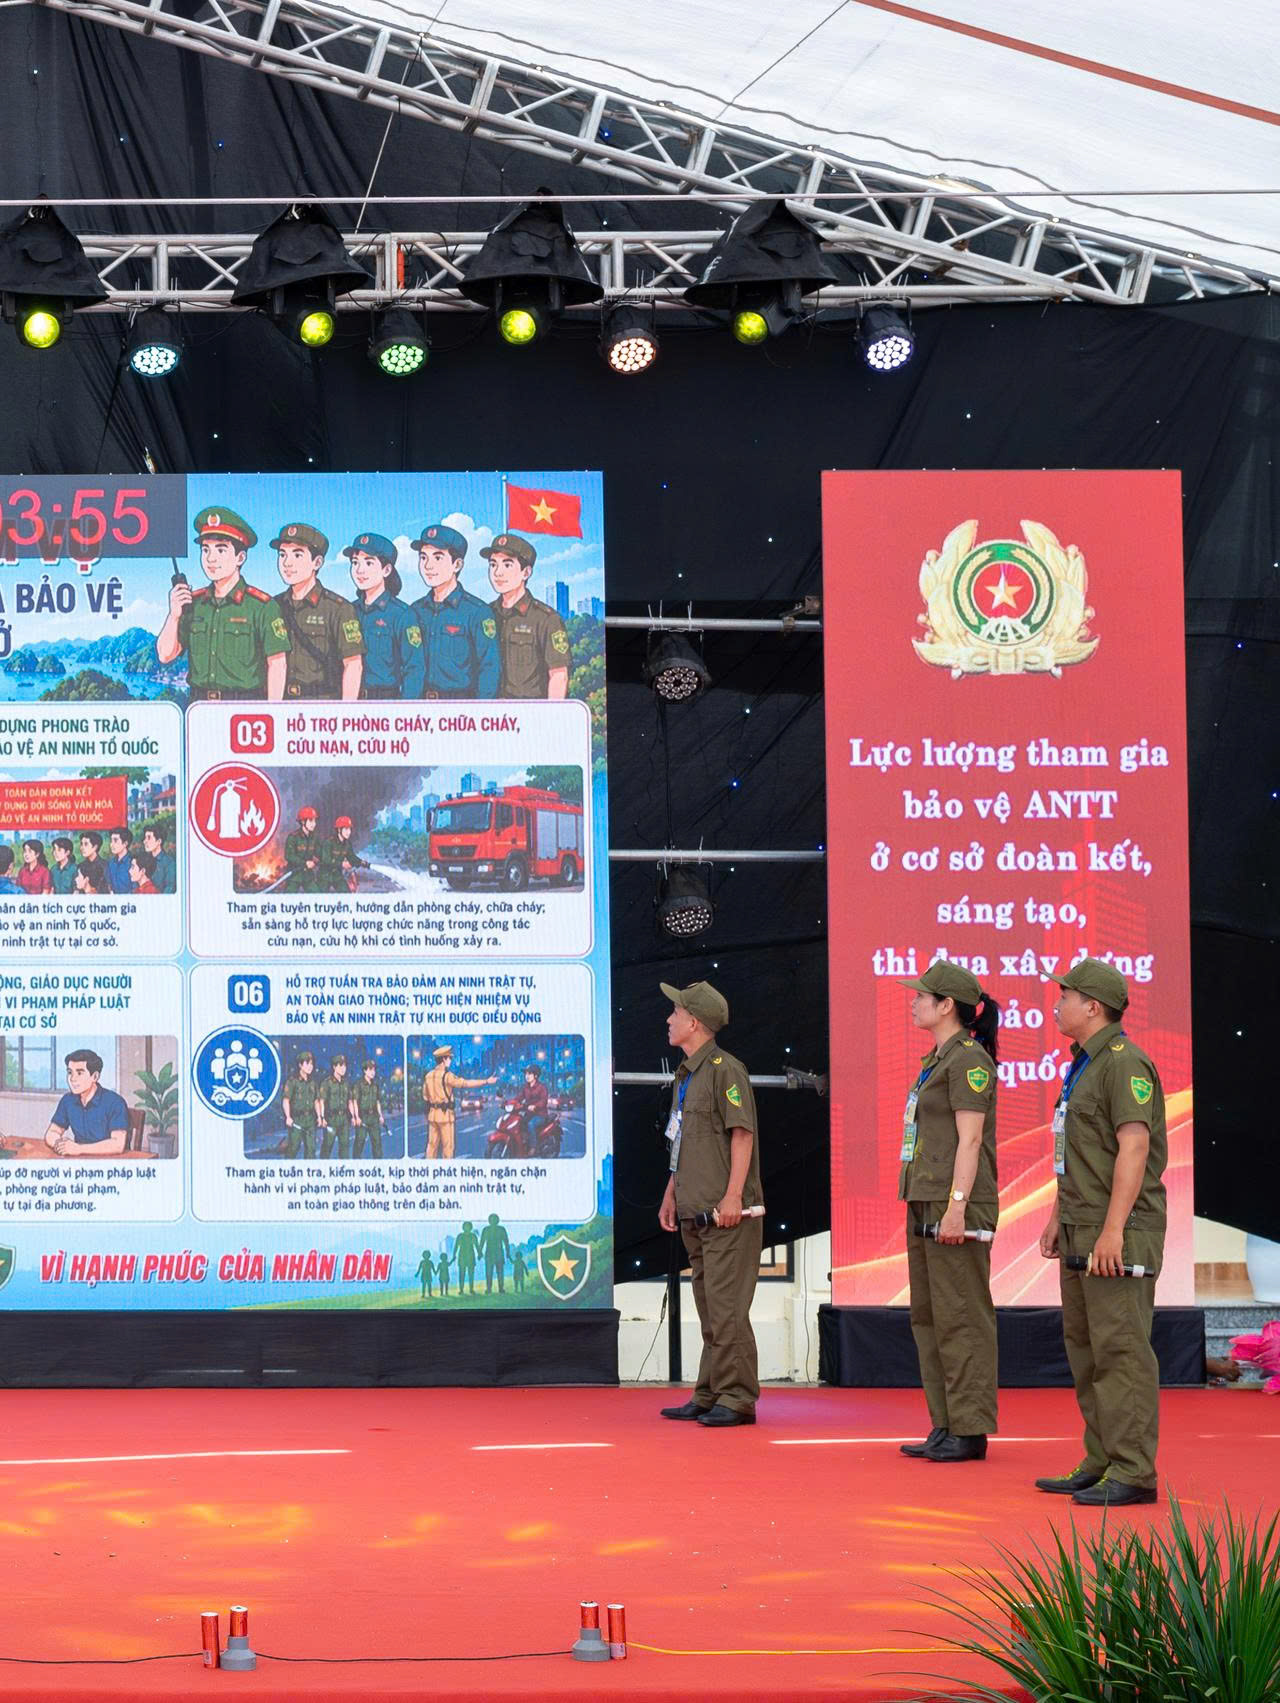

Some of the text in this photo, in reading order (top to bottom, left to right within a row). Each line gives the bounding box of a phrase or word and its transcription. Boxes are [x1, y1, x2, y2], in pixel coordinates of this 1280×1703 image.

[16, 575, 76, 613] BẢO
[86, 576, 123, 619] VỆ
[42, 718, 89, 733] PHONG
[93, 715, 130, 733] TRÀO
[237, 720, 267, 746] 03
[310, 717, 338, 735] TRỢ
[342, 714, 390, 732] PHÒNG
[394, 714, 434, 734] CHÁY,
[438, 714, 477, 732] CHỮA
[480, 714, 520, 734] CHÁY,
[16, 738, 34, 758] VỆ
[38, 741, 58, 755] AN
[62, 741, 96, 755] NINH
[121, 736, 159, 756] QUỐC
[287, 736, 410, 757] CỨU NẠN, CỨU HỘ
[849, 738, 1169, 772] Lực lượng tham gia
[902, 789, 1118, 824] bảo vệ ANTT
[870, 838, 1152, 876] ở cơ sở đoàn kết,
[937, 895, 1086, 930] sáng tạo,
[872, 947, 918, 976] thi
[1000, 949, 1059, 982] xây
[30, 974, 60, 990] GIÁO
[64, 976, 89, 992] DỤC
[93, 973, 132, 989] NGƯỜI
[234, 981, 264, 1006] 06
[286, 994, 302, 1006] AN
[305, 992, 334, 1006] TOÀN
[338, 994, 365, 1006] GIAO
[368, 992, 409, 1007] THÔNG;
[413, 994, 442, 1008] THỰC
[446, 992, 472, 1008] HIỆN
[515, 994, 530, 1008] VỤ
[41, 1248, 390, 1287] VÌ HẠNH PHÚC CỦA NHÂN DÂN
